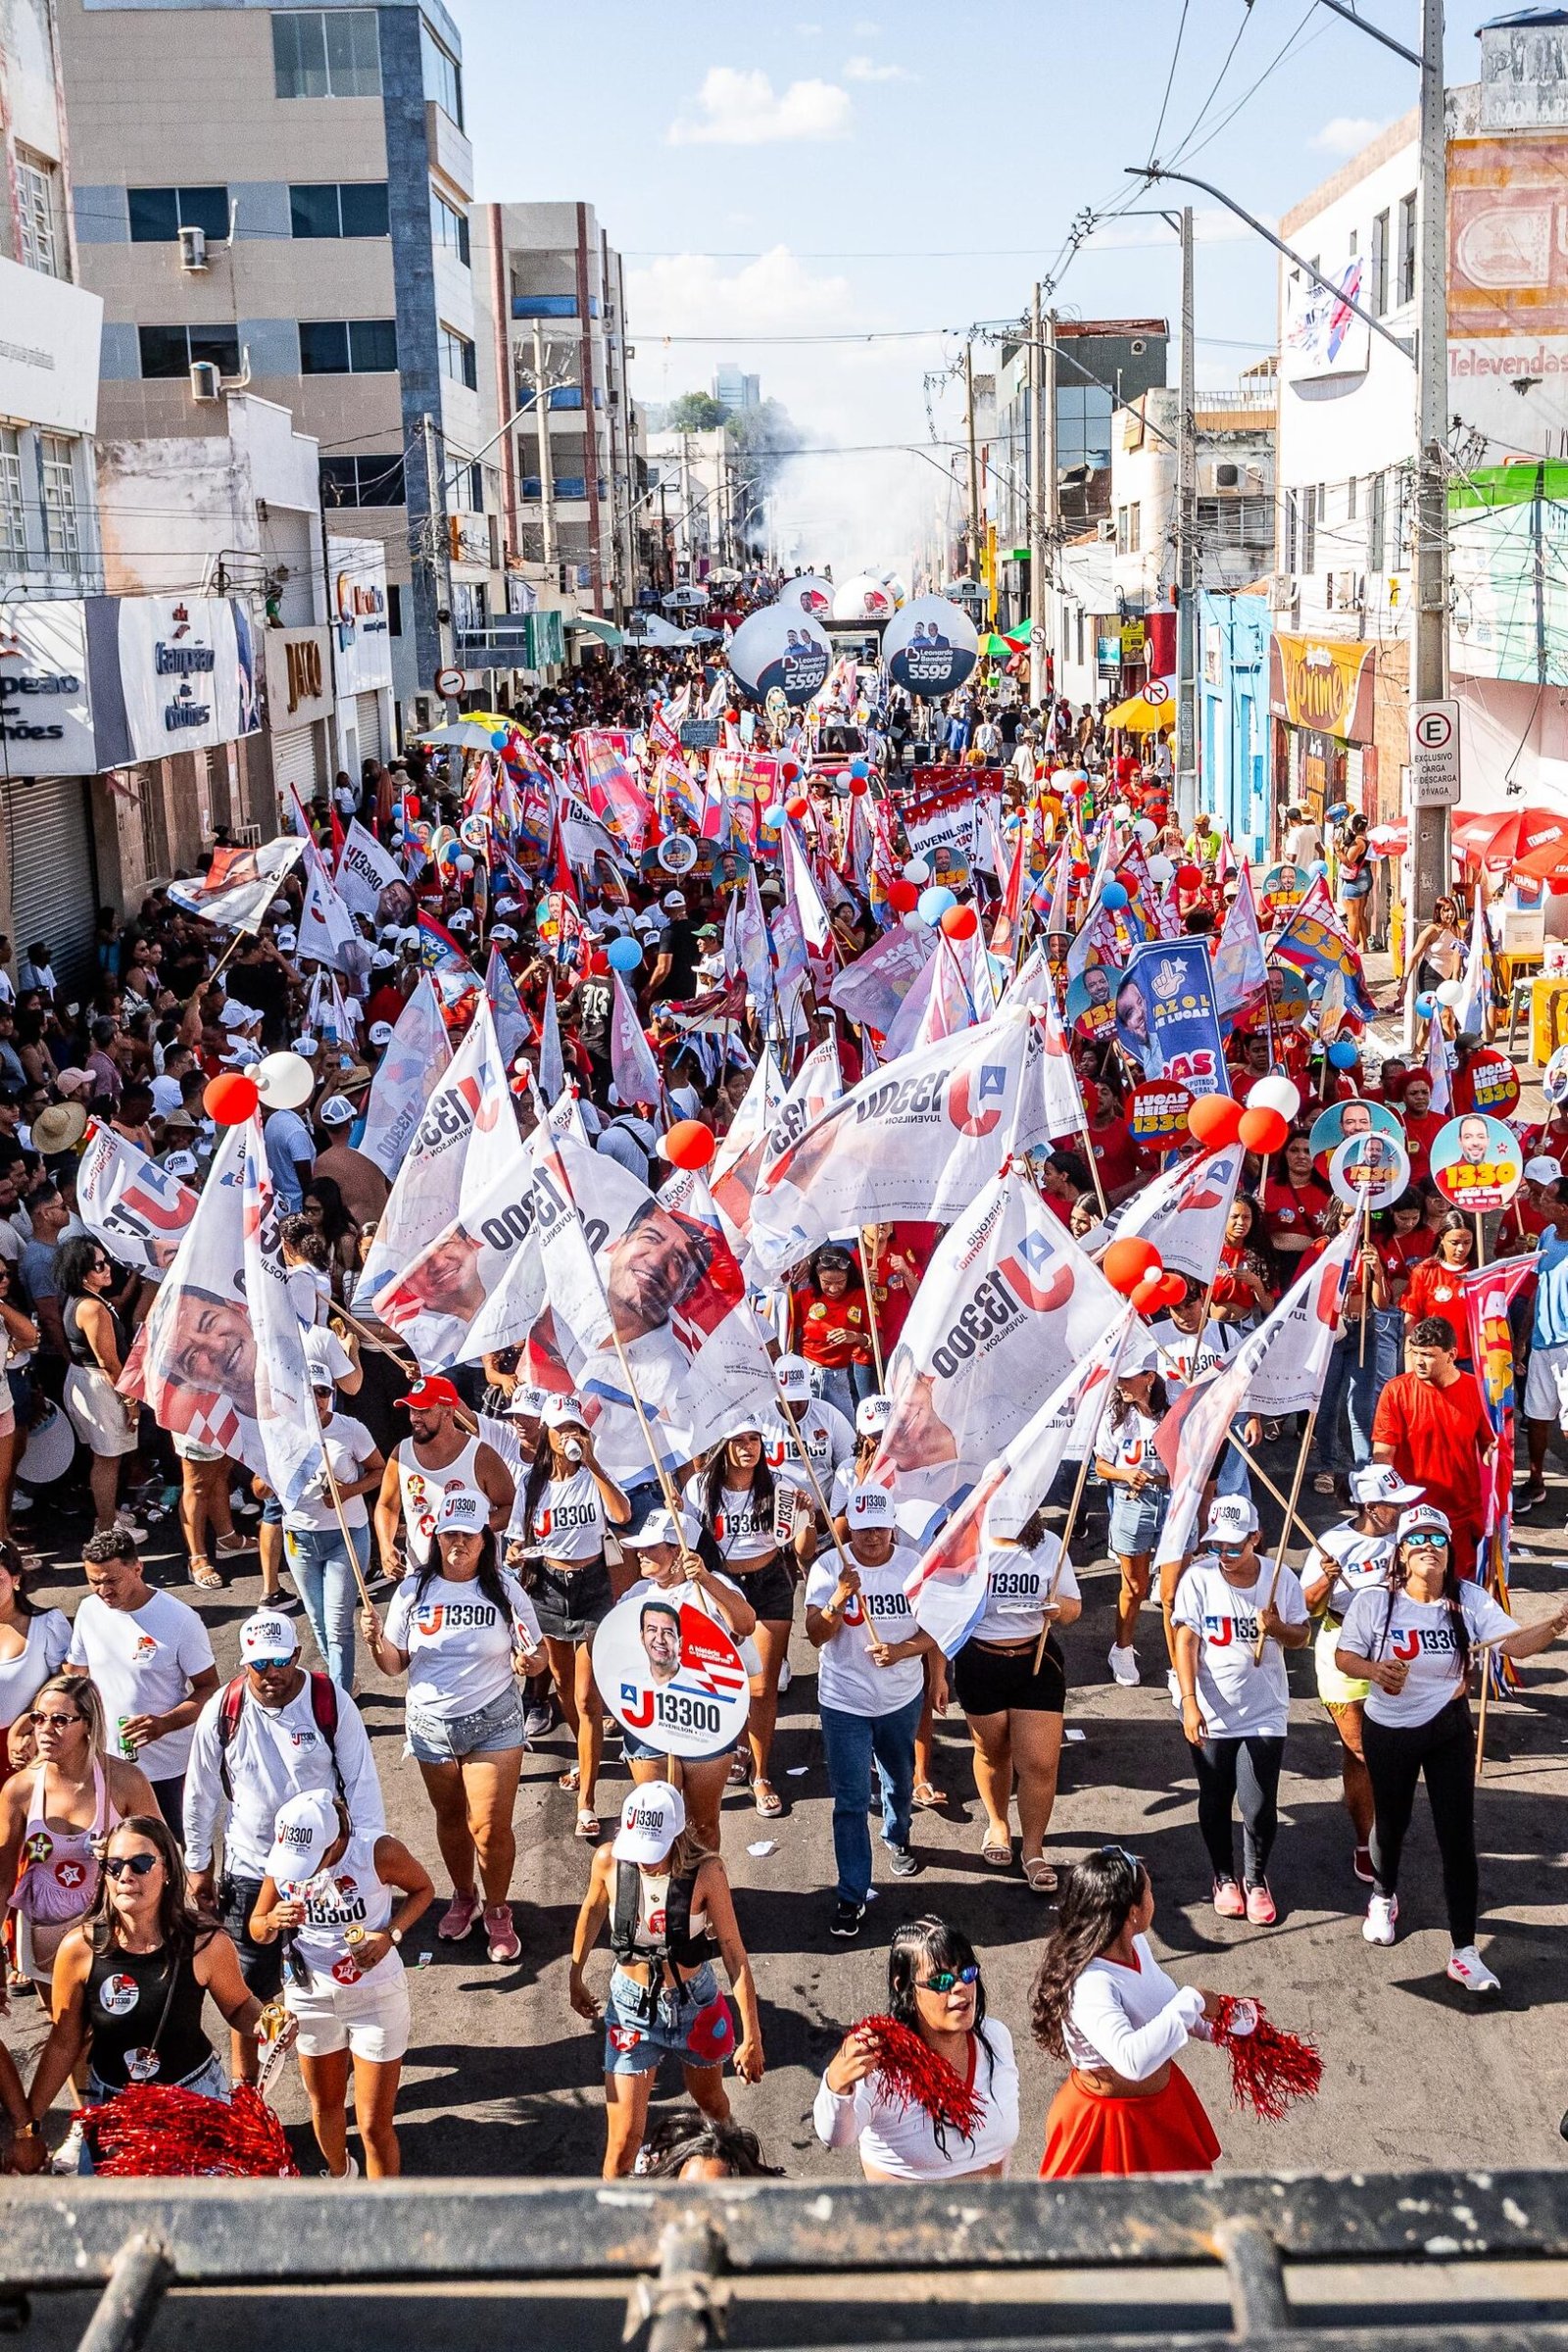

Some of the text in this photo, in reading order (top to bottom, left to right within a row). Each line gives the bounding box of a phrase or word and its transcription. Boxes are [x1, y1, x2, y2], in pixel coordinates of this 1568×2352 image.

[907, 663, 952, 680] 5599
[784, 671, 825, 691] 5599
[1426, 720, 1443, 742] E
[1414, 753, 1452, 762] EXCLUSIVO
[1421, 764, 1446, 773] CARGA
[1420, 775, 1457, 784] DESCARGA
[1167, 1007, 1210, 1024] LUCAS
[1472, 1060, 1512, 1080] LUCAS
[1134, 1092, 1189, 1107] LUCAS
[1475, 1081, 1517, 1105] 1330
[1134, 1104, 1168, 1117] REIS
[1349, 1166, 1398, 1181] 1330
[1446, 1161, 1516, 1190] 1330
[455, 1497, 477, 1512] 13300
[866, 1494, 887, 1508] 13300
[552, 1502, 597, 1528] 13300
[992, 1573, 1040, 1594] 13300
[445, 1604, 496, 1627] 13300
[656, 1692, 720, 1734] 13300
[658, 1721, 694, 1735] JUVENILSON
[636, 1810, 664, 1829] 13300
[285, 1828, 313, 1843] 13300
[65, 1869, 76, 1882] PT
